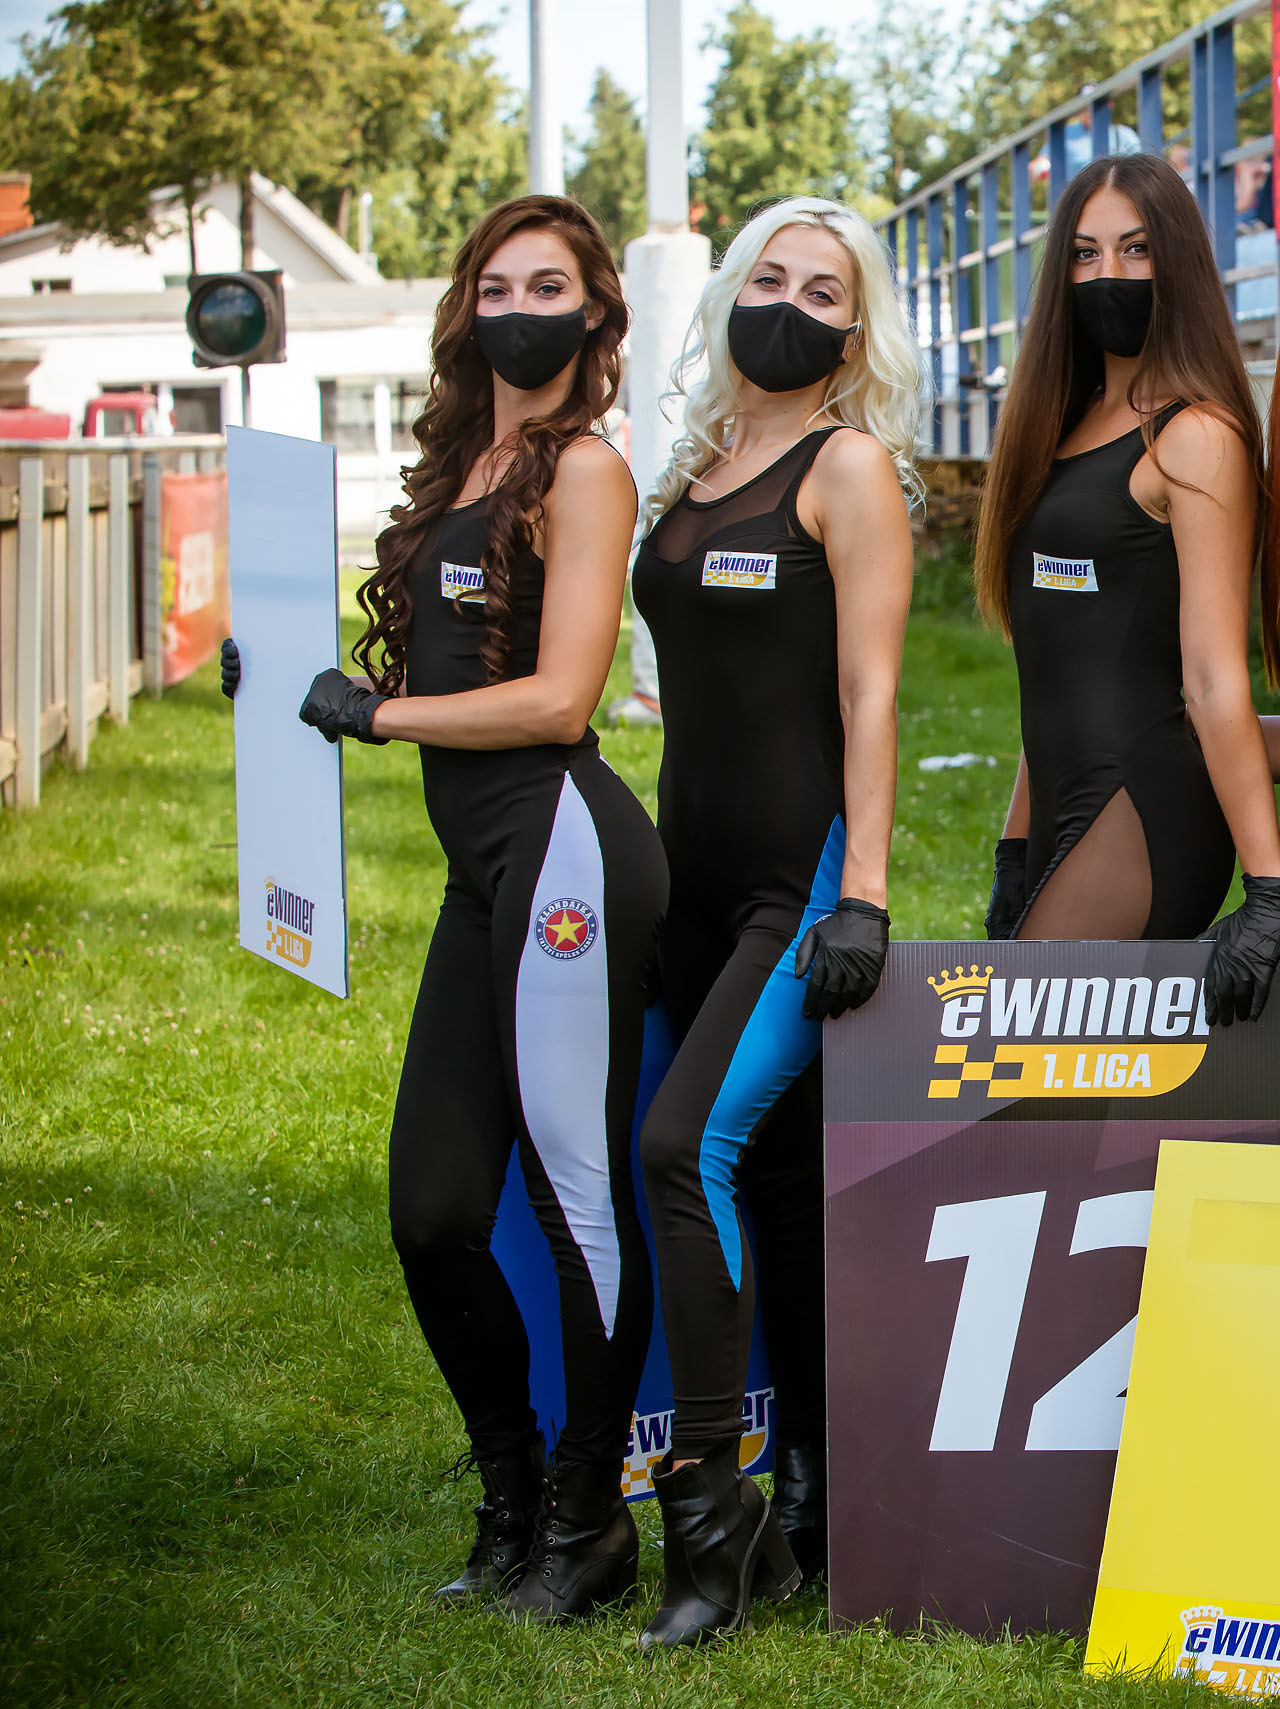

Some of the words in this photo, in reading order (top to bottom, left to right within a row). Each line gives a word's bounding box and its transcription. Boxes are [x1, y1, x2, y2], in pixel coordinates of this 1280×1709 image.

[735, 575, 754, 585] LIGA
[538, 900, 593, 923] KLONDAIKA
[1042, 1053, 1063, 1089] 1.
[1072, 1053, 1152, 1089] LIGA
[924, 1190, 1155, 1451] 12
[1234, 1668, 1247, 1692] 1.
